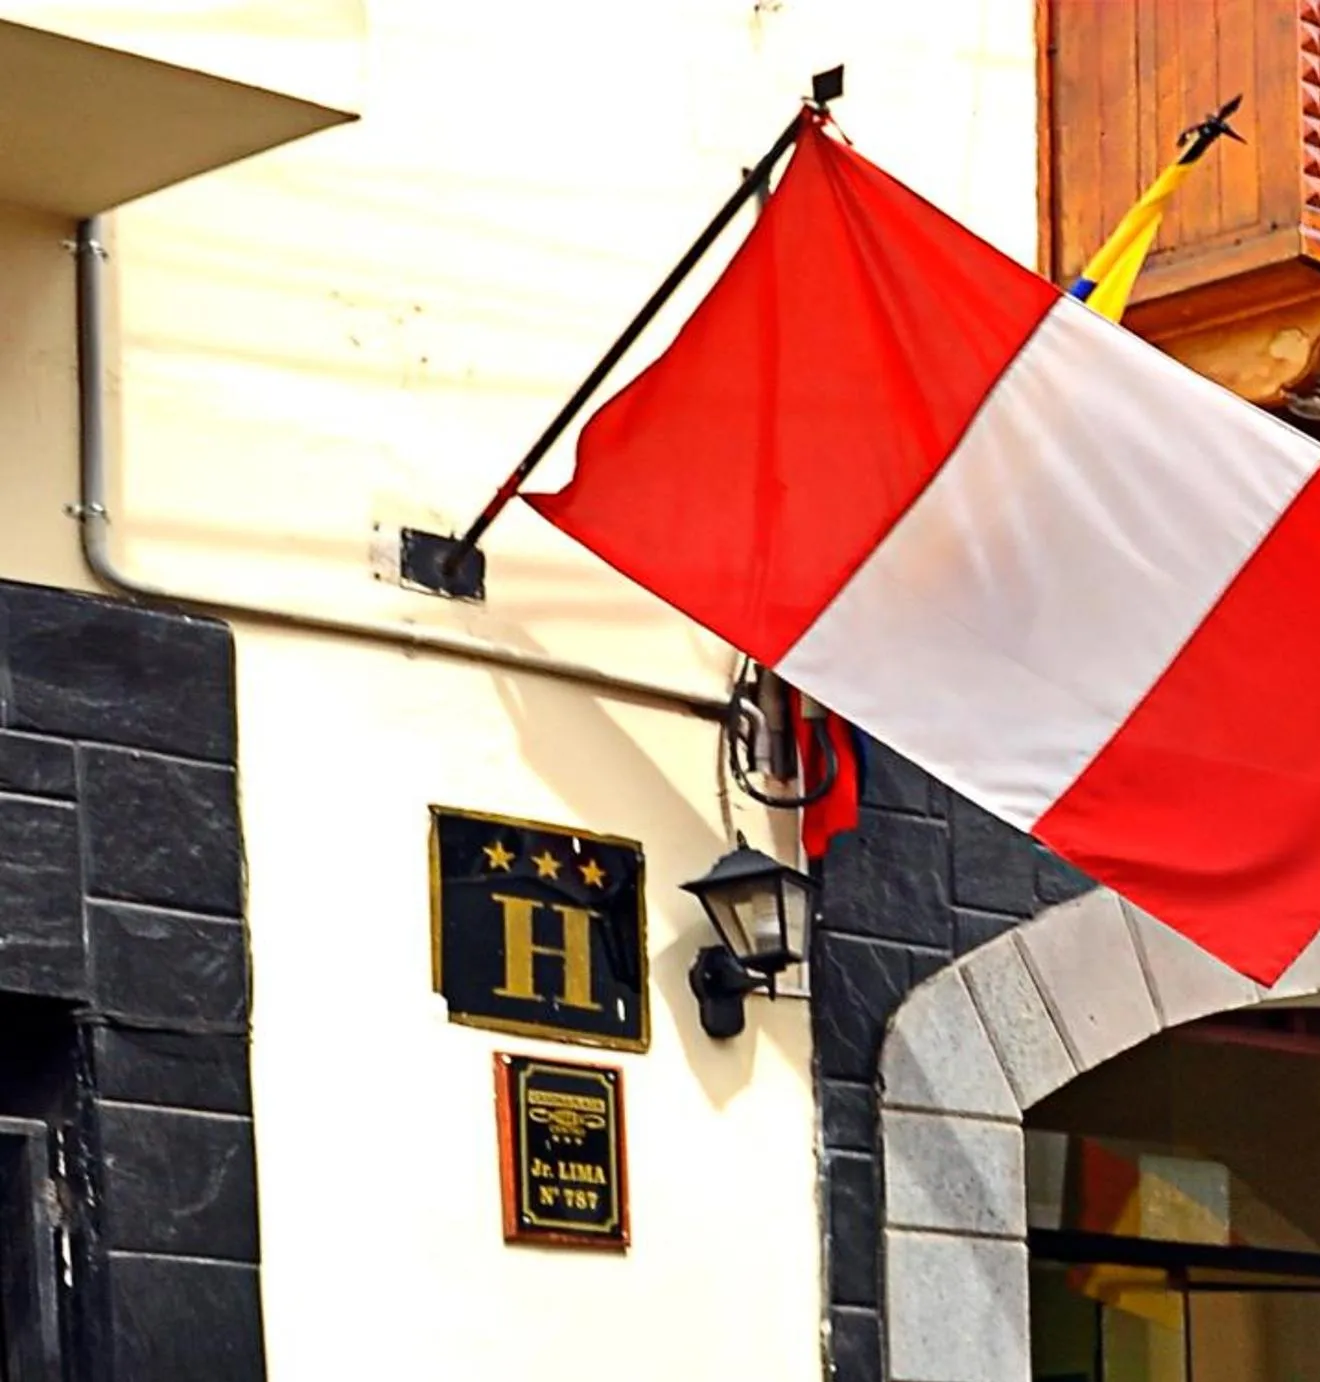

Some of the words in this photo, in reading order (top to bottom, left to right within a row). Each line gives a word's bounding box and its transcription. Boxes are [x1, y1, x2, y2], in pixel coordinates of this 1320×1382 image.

[492, 893, 603, 1010] H
[530, 1158, 555, 1179] Jr.
[558, 1161, 607, 1185] LIMA
[562, 1187, 598, 1211] 787
